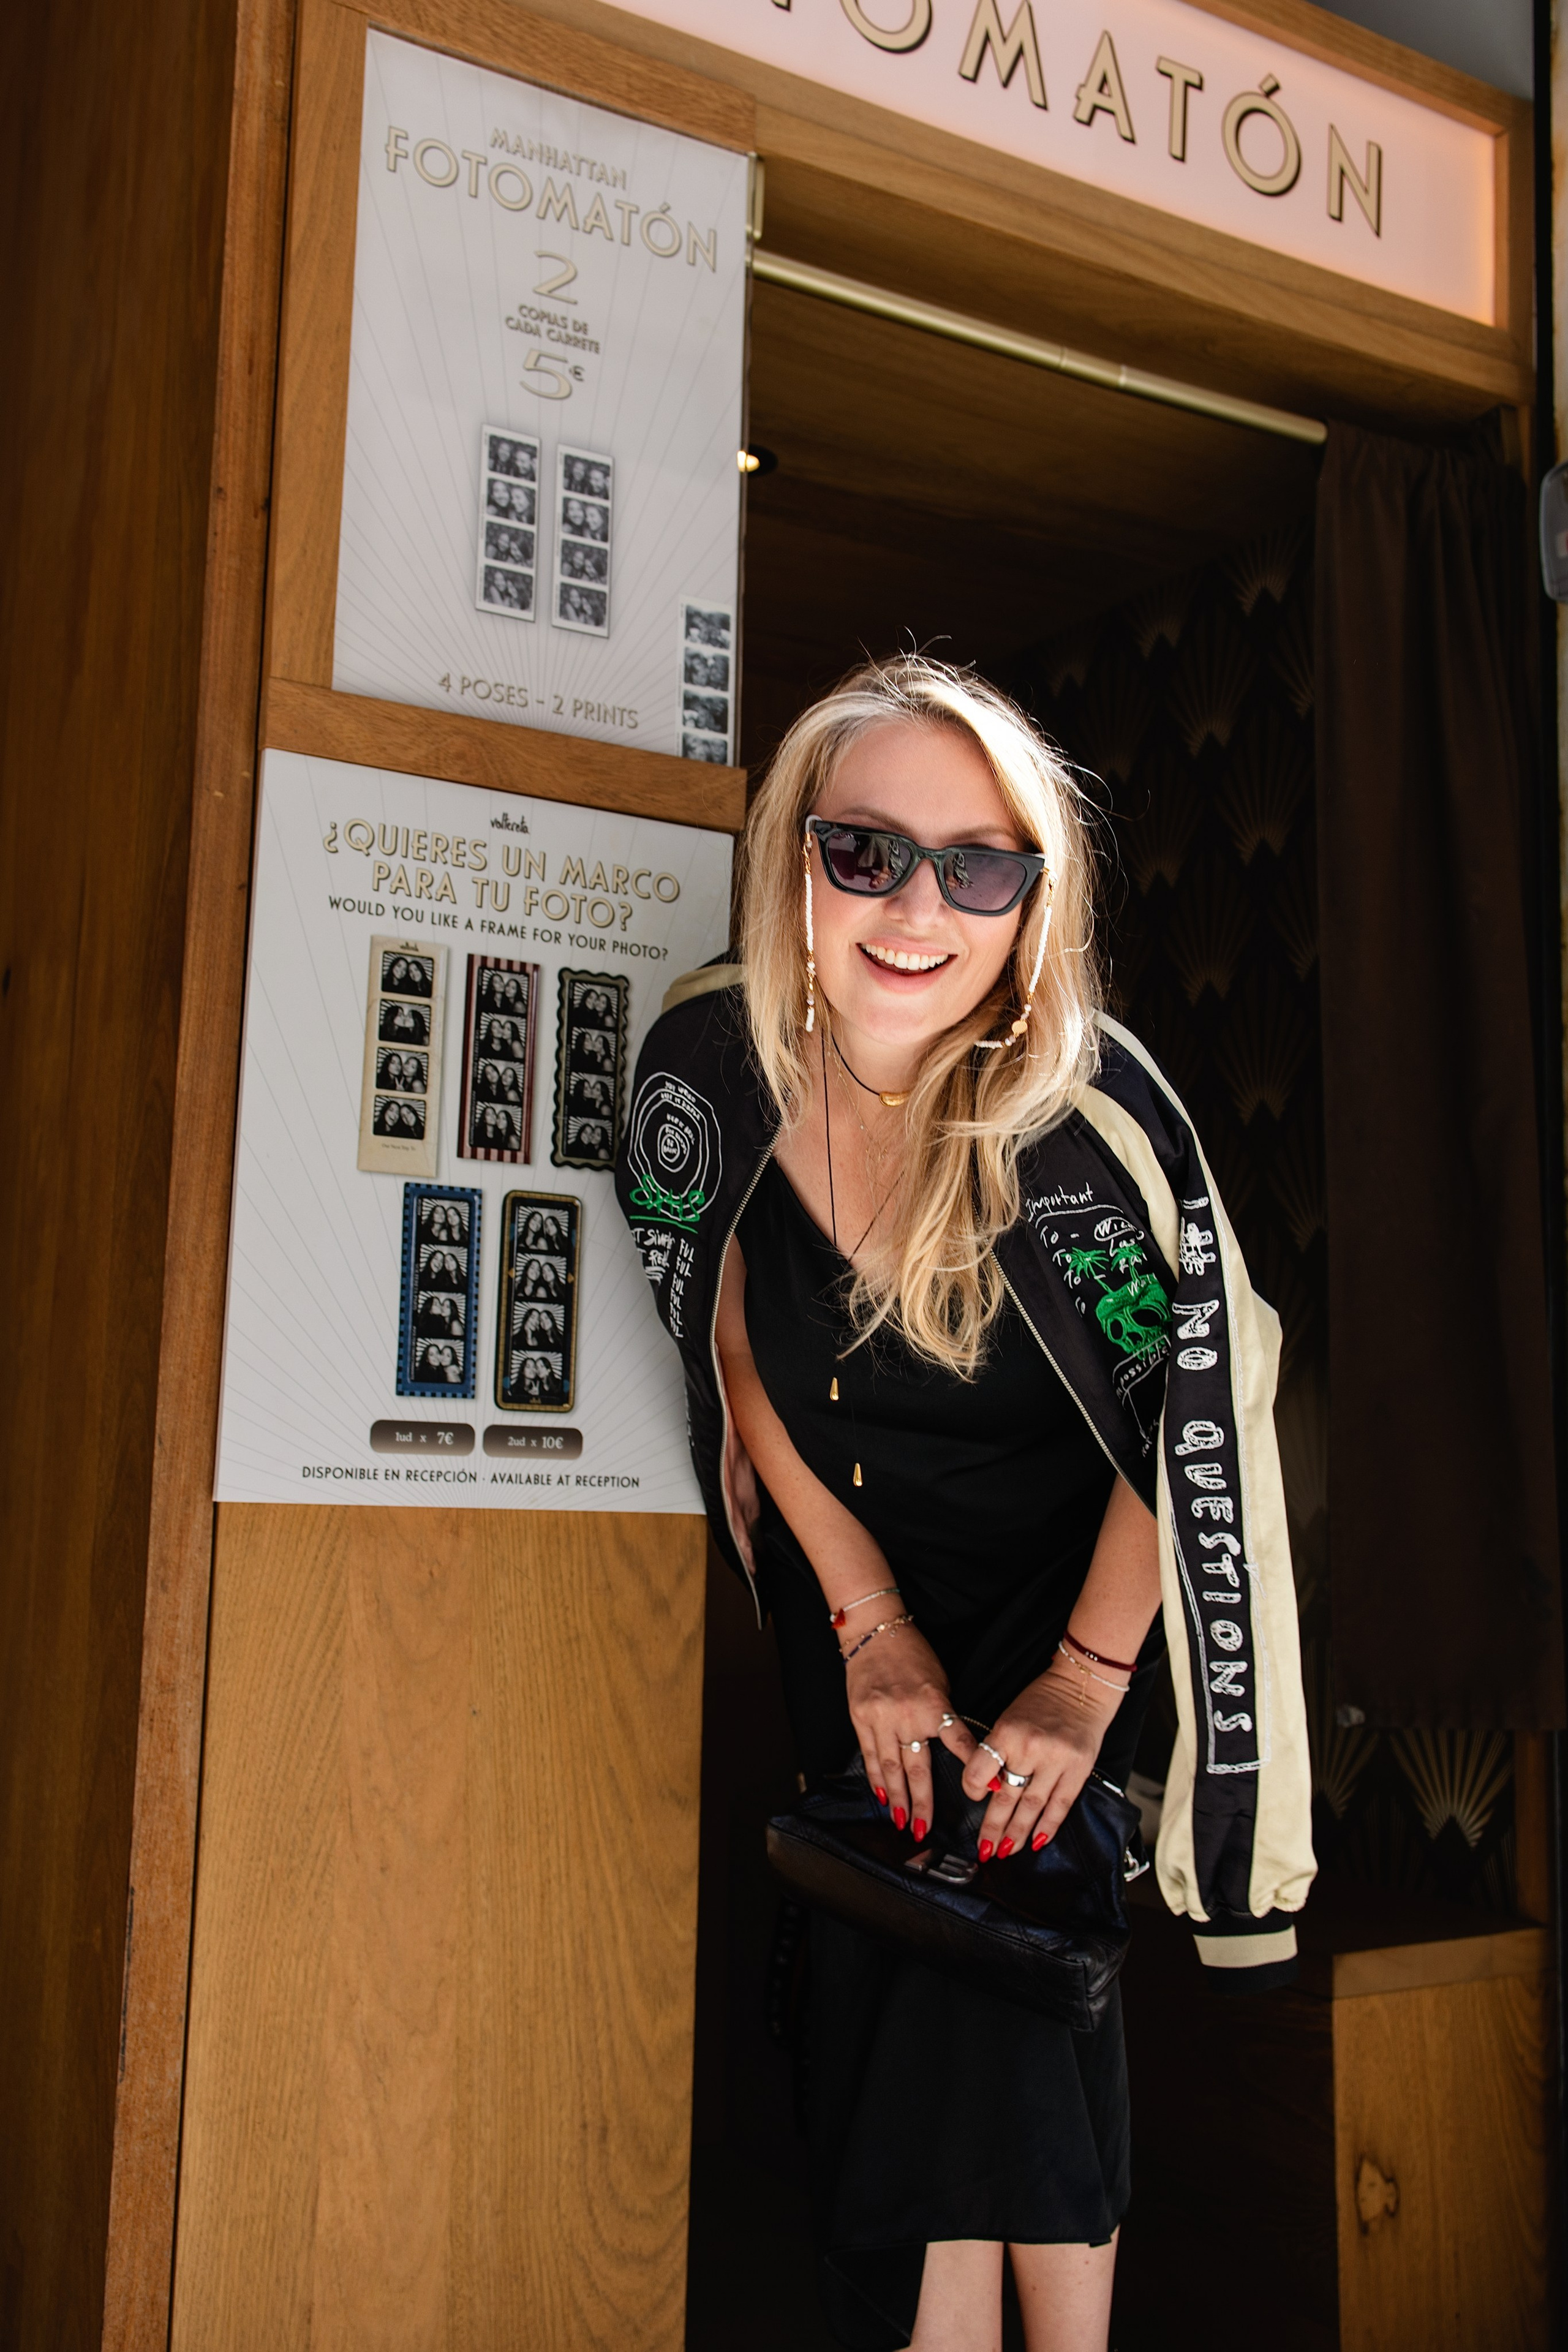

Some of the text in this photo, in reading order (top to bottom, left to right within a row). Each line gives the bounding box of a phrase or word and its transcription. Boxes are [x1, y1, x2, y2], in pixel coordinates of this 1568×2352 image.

[771, 0, 1383, 238] OMATÓN
[490, 127, 627, 190] MANHATTAN
[385, 125, 717, 273] FOTOMATÓN
[532, 249, 578, 305] 2
[505, 315, 600, 355] CADA CARRETE
[519, 304, 589, 335] COPIAS DE
[439, 672, 452, 693] 4
[461, 676, 529, 707] POSES
[552, 695, 564, 715] 2
[573, 698, 639, 729] PRINTS
[323, 818, 680, 903] ¿QUIERES UN MARCO
[371, 861, 634, 932] PARA TU FOTO?
[328, 895, 669, 961] WOULD YOU LIKE A FRAME FOR YOUR PHOTO?
[1025, 1182, 1094, 1223] Important
[1172, 1299, 1219, 1371] NO
[420, 1434, 427, 1443] x
[436, 1431, 454, 1446] 7€
[507, 1436, 564, 1450] 2ud x 10€
[302, 1466, 379, 1480] DISPONIBLE
[384, 1468, 400, 1480] EN
[405, 1468, 477, 1483] RECEPCIÓN
[490, 1472, 552, 1486] AVAILABLE
[556, 1474, 570, 1487] AT
[575, 1475, 639, 1488] RECEPTION
[1174, 1419, 1253, 1733] QUESTIONS
